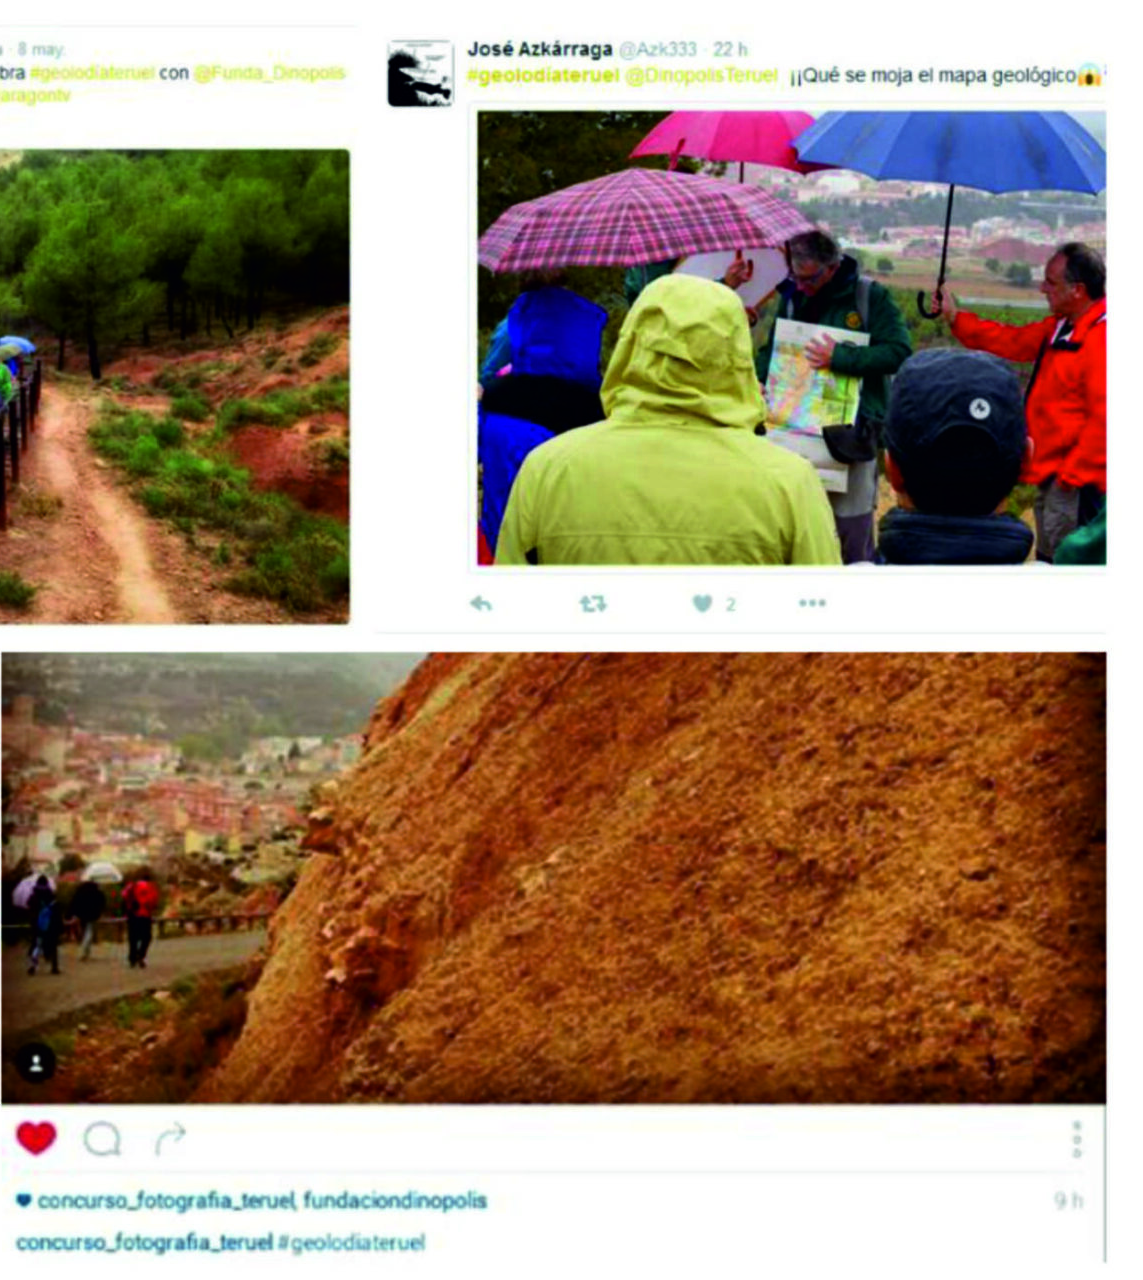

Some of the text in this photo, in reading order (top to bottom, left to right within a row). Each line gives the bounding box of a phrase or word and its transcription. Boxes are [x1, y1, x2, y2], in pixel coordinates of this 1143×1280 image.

[17, 41, 27, 56] 8
[467, 40, 514, 57] José
[518, 40, 613, 60] Azkárraga
[619, 40, 698, 59] @Azk333
[712, 41, 734, 57] 22
[738, 41, 749, 56] h
[159, 68, 190, 80] con
[194, 64, 346, 84] @Funda_Dinopolis
[625, 66, 778, 87] @DinopolisTeruel
[845, 70, 867, 83] se
[871, 68, 913, 87] moja
[918, 67, 934, 83] el
[939, 70, 987, 87] mapa
[992, 66, 1077, 87] geológico
[726, 597, 737, 612] 2
[303, 1190, 488, 1213] fundaciondinopolis
[1054, 1190, 1084, 1210] 9 h
[16, 1232, 427, 1256] concurso_fotografia_teruel #geolodiateruel
